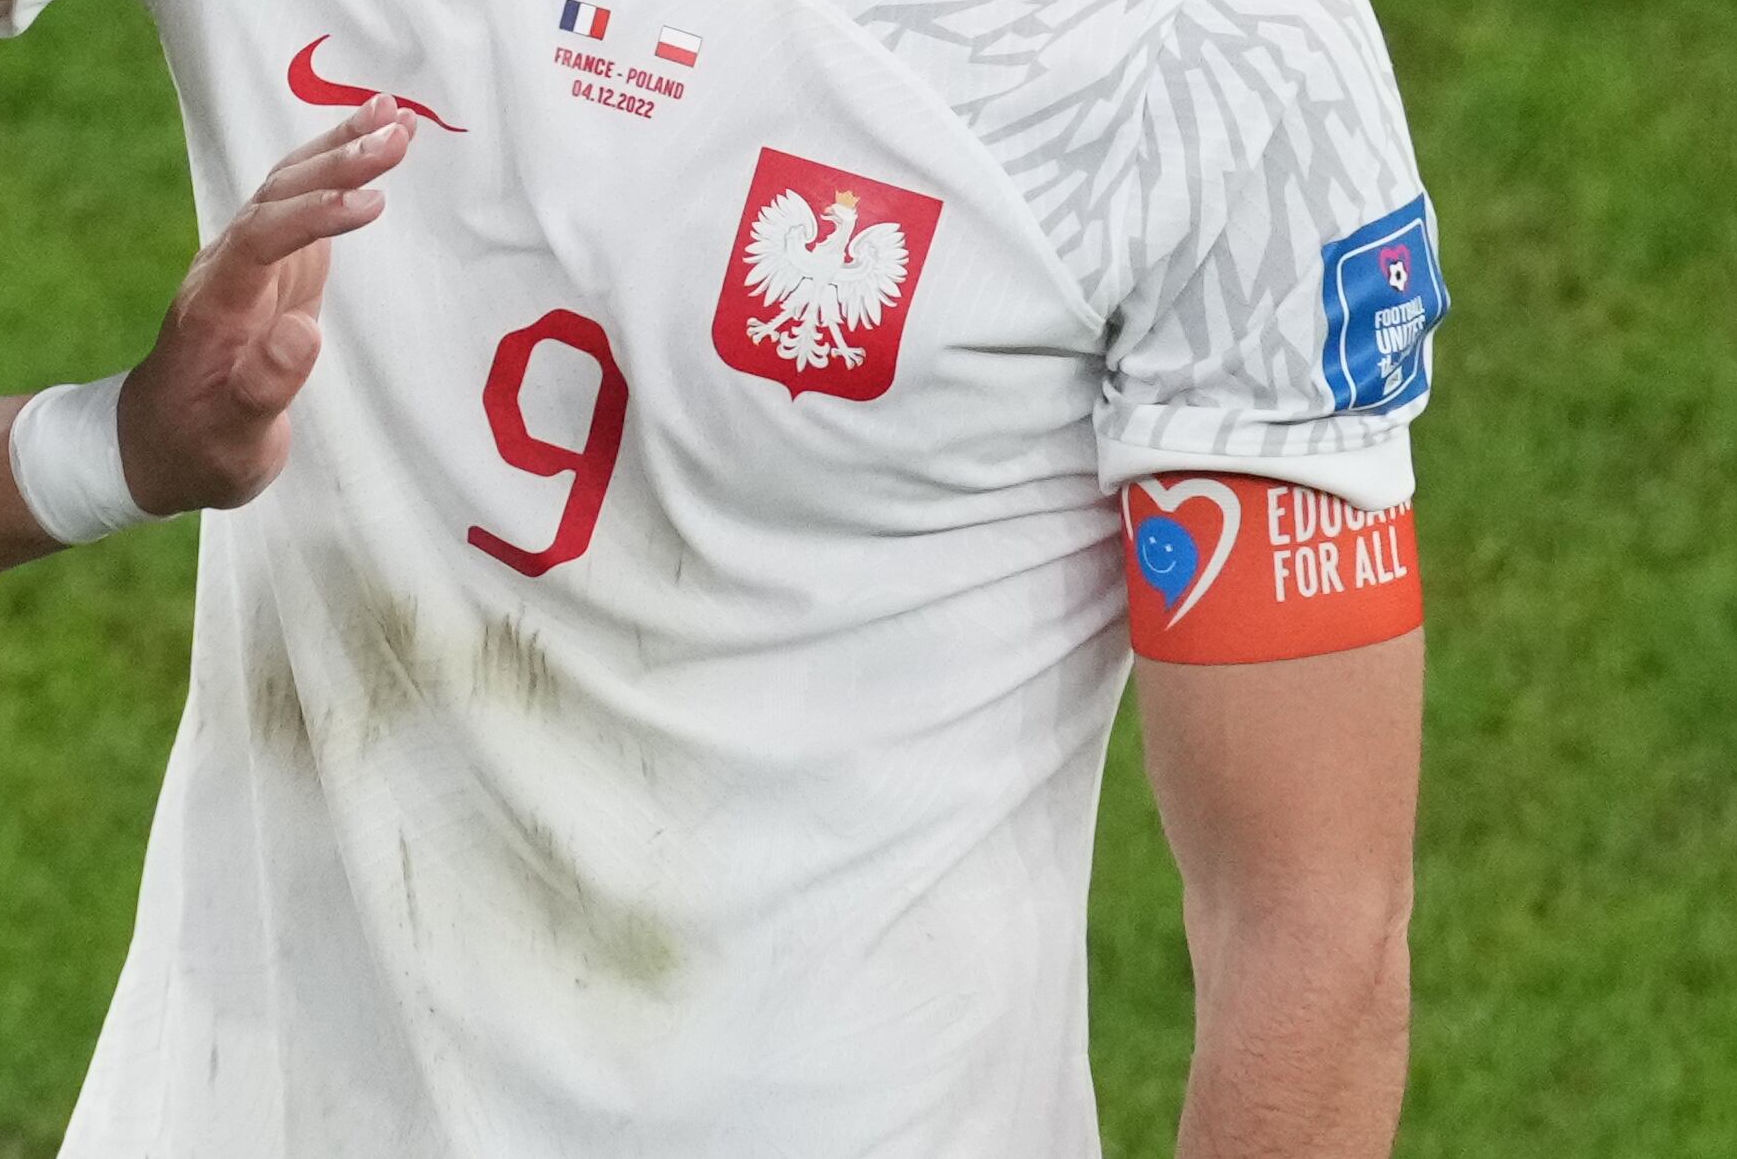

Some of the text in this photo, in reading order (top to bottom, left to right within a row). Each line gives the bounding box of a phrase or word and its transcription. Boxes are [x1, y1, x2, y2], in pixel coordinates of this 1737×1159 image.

[554, 47, 614, 79] FRANCE
[626, 67, 685, 100] POLAND
[572, 80, 655, 119] 04.12.2022
[468, 308, 629, 577] 9
[1273, 525, 1408, 602] FOR ALL
